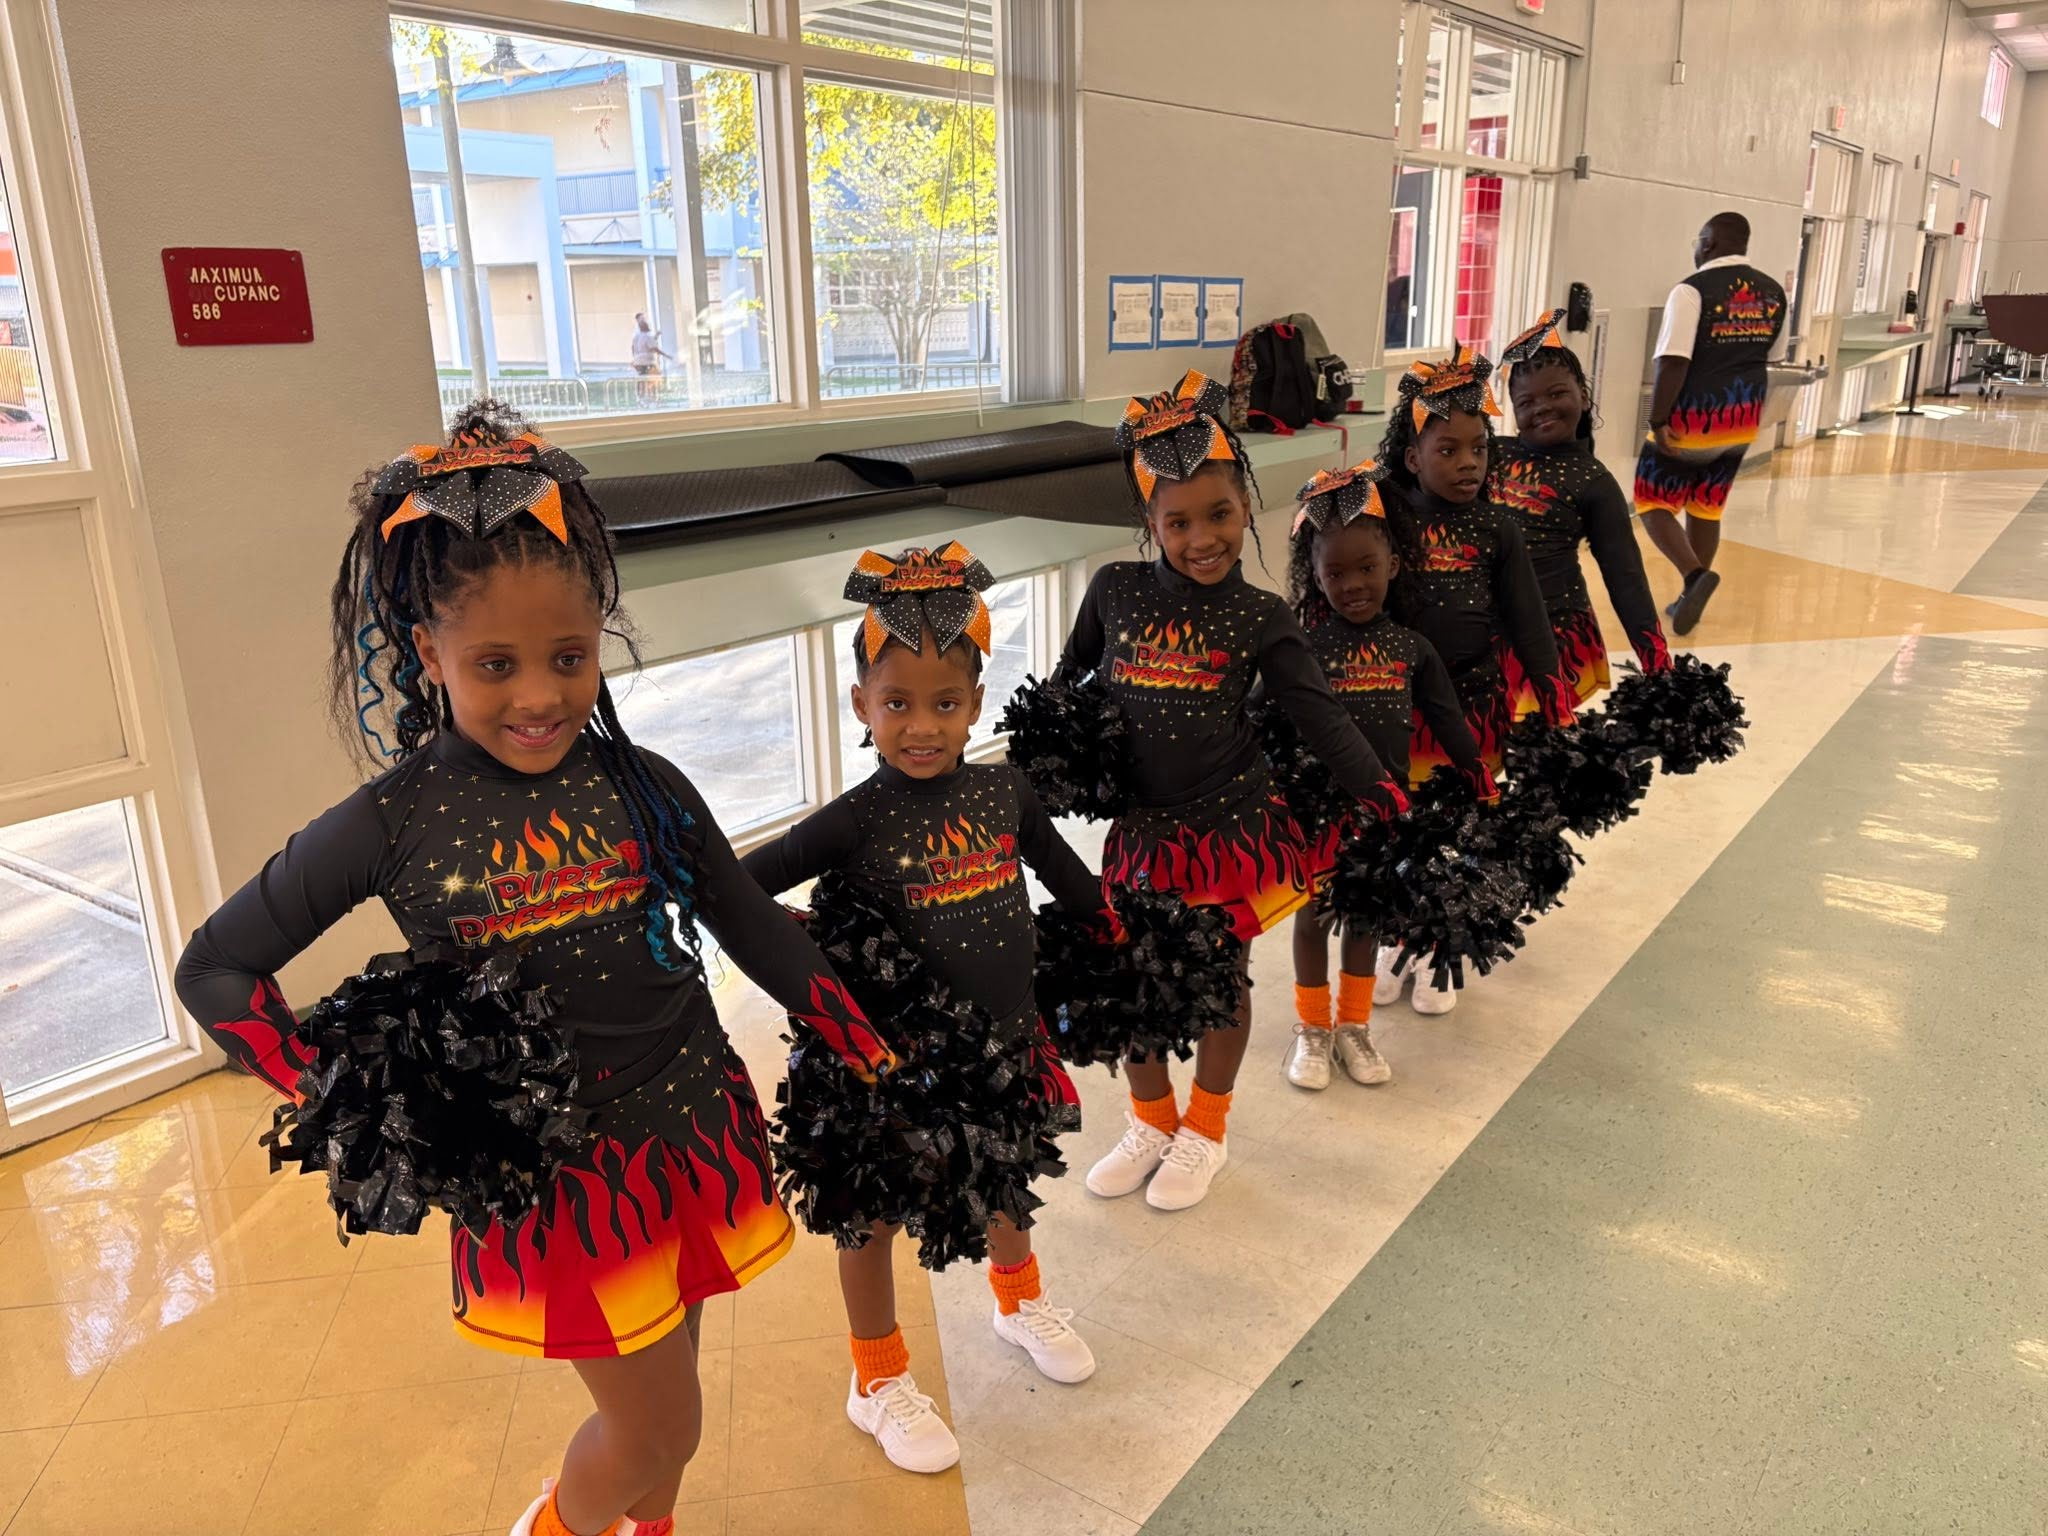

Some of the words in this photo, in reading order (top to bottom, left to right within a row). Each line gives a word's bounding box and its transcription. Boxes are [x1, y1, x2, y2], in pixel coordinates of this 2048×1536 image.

[192, 303, 221, 320] 586
[1728, 302, 1764, 319] PURE
[1711, 321, 1773, 337] PRESSURE
[1134, 641, 1209, 672] PURE
[1111, 656, 1226, 692] PRESSURE
[924, 847, 1002, 885] PURE
[482, 857, 621, 916] PURE
